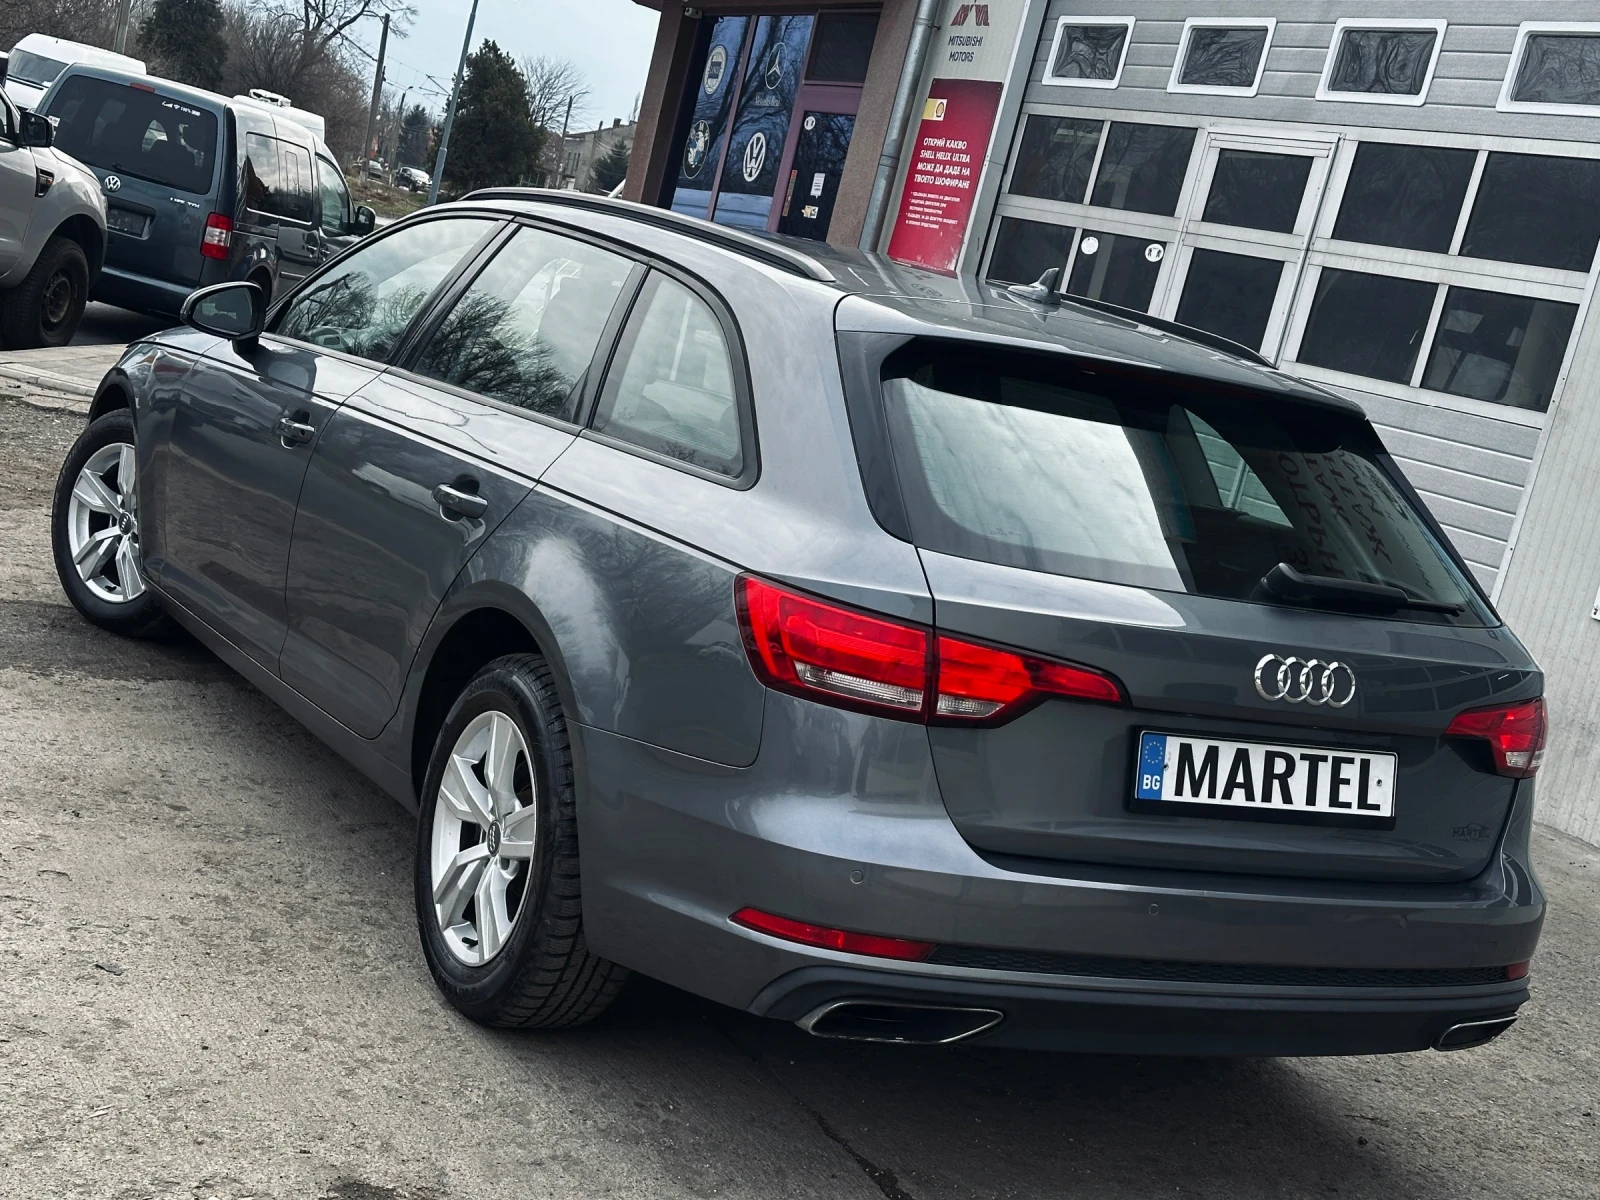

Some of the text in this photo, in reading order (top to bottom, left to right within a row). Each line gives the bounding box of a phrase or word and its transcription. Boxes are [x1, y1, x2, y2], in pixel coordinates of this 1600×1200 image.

[948, 35, 983, 47] MITSUBISHI
[948, 51, 975, 62] MOTORS
[923, 137, 967, 150] ОТКРИЙ КАКВО
[919, 149, 971, 163] SHELL HELIX ULTRA
[916, 162, 971, 176] МОЖЕ ДА ДАДЕ НА
[935, 176, 970, 189] ШОФИРАНЕ
[1142, 774, 1161, 791] BG
[1173, 742, 1382, 811] MARTEL
[1452, 827, 1490, 838] MARTEL
